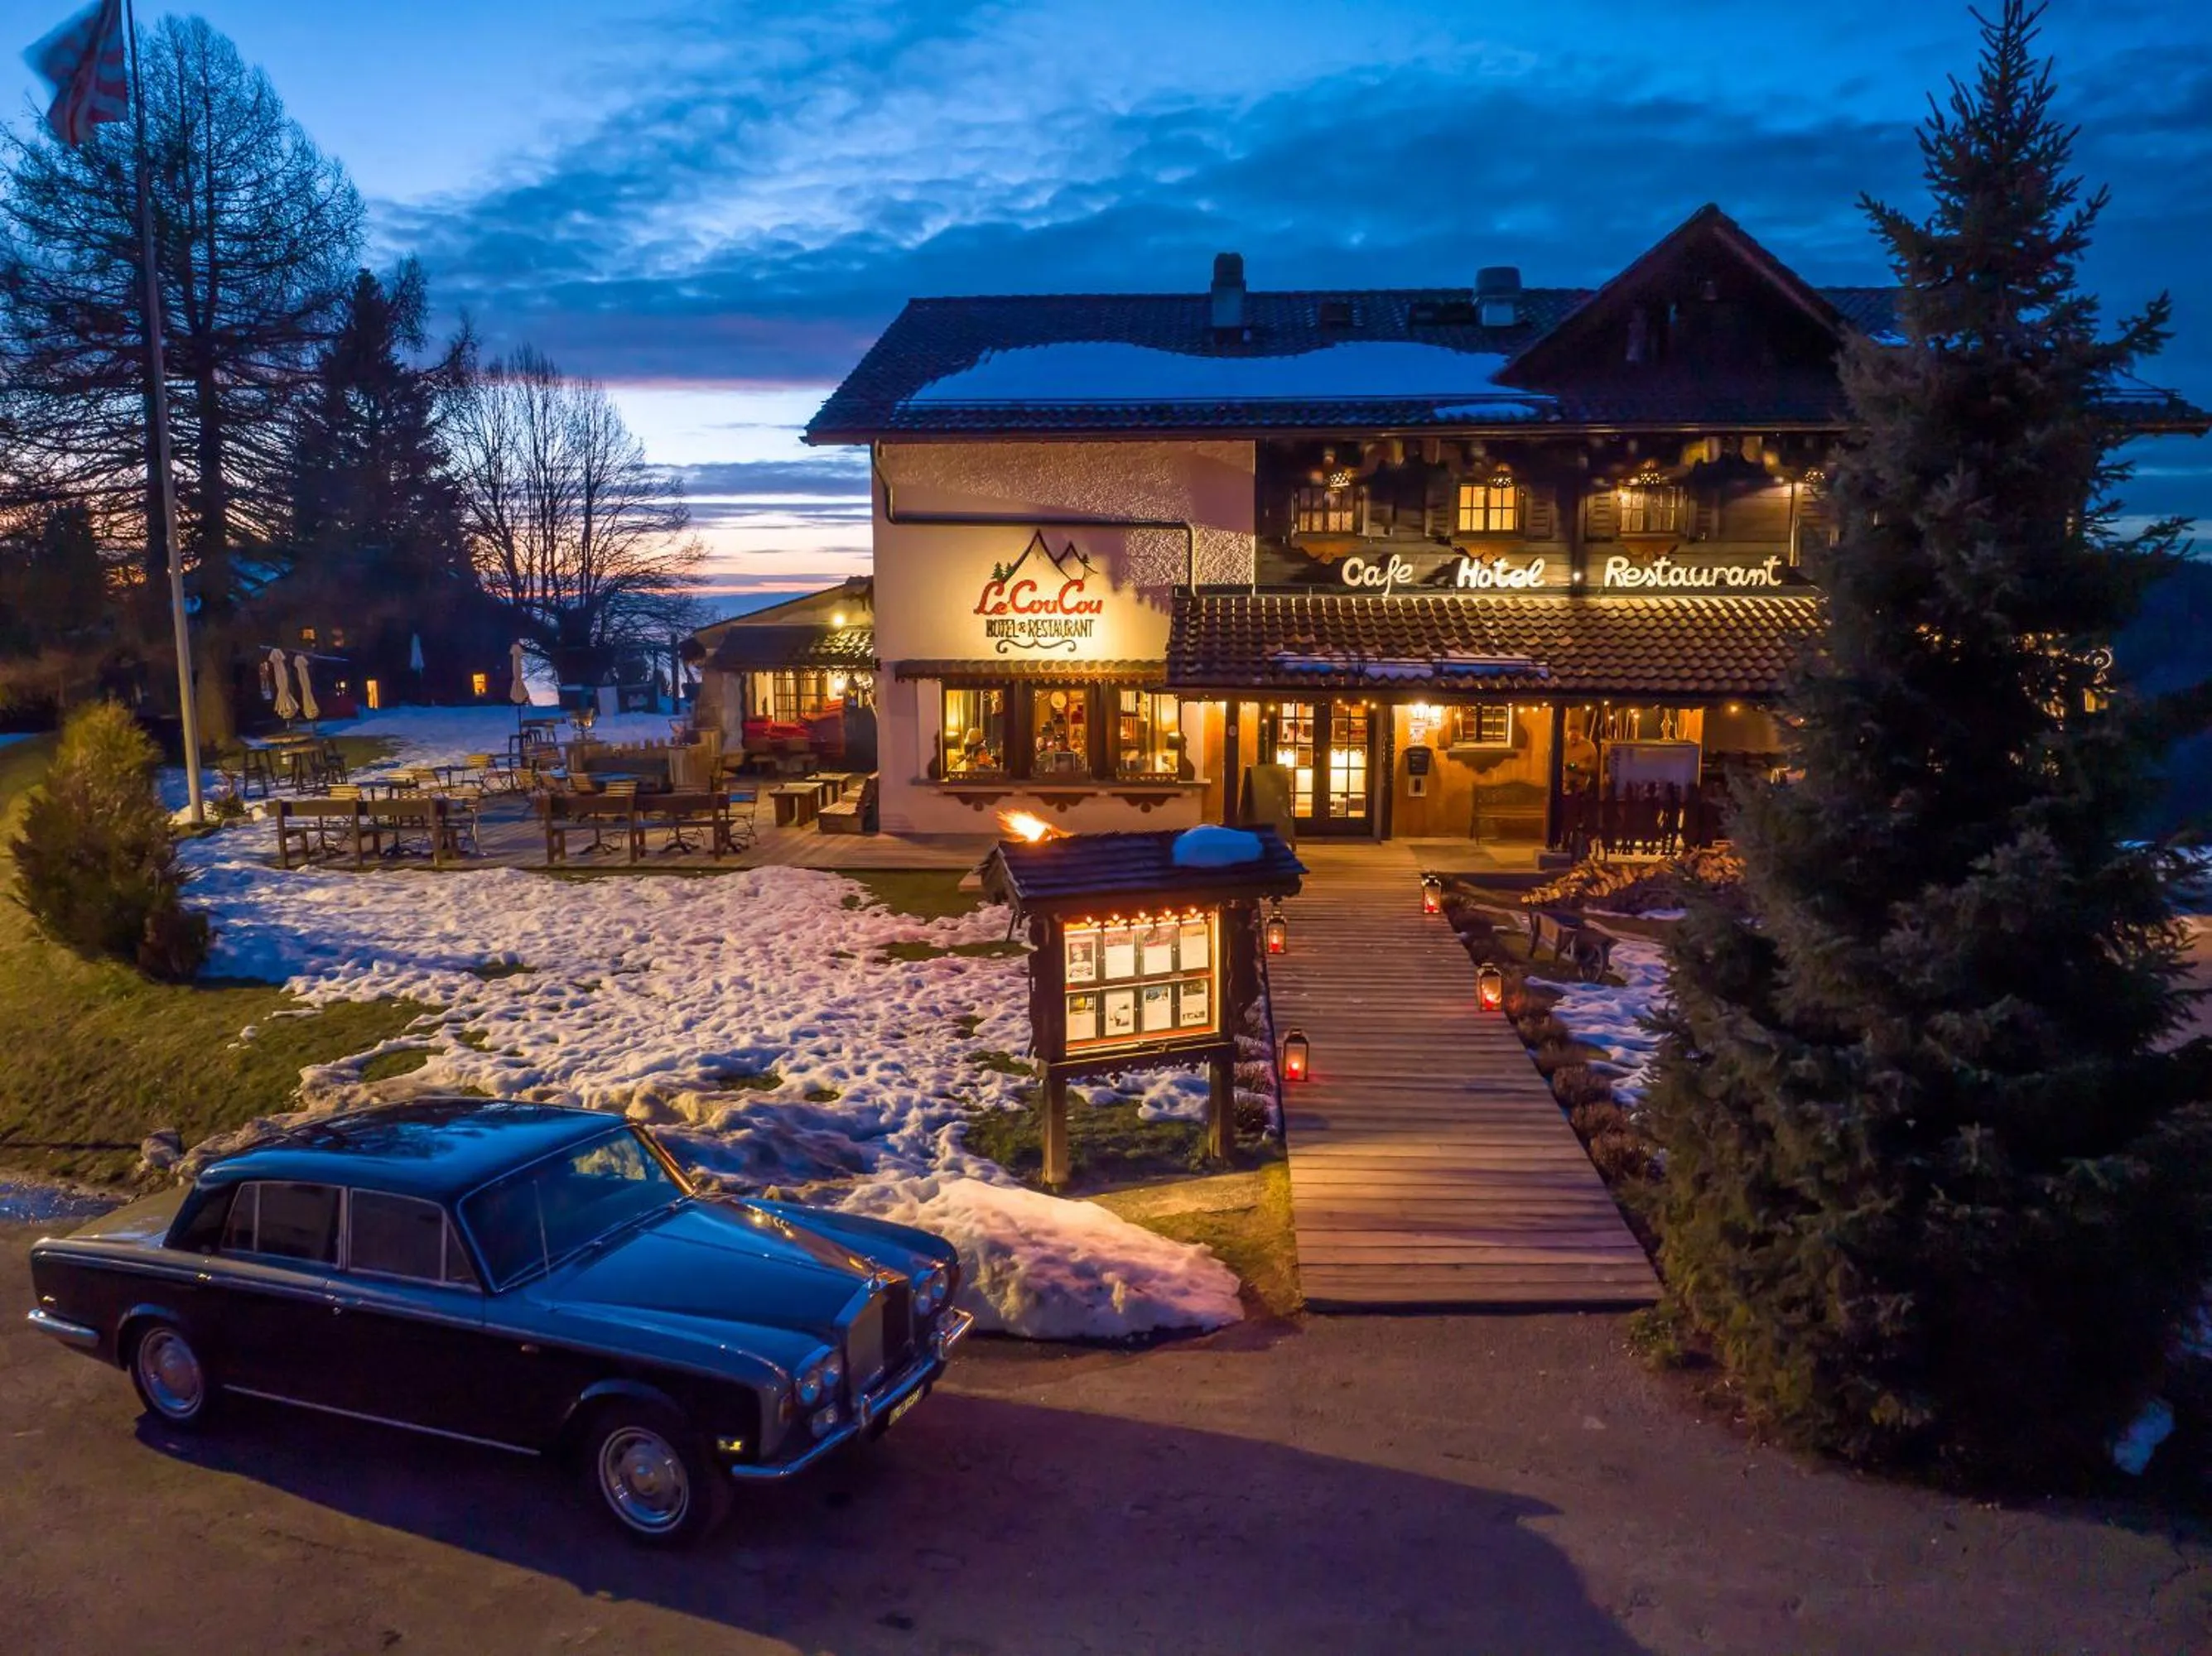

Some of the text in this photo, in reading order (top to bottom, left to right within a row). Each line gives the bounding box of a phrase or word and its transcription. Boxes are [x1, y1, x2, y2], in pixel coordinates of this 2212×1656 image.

[1342, 555, 1781, 597] Cafe Hotel Restaurant
[986, 619, 1019, 638] HOTEL
[1027, 619, 1094, 638] RESTAURANT
